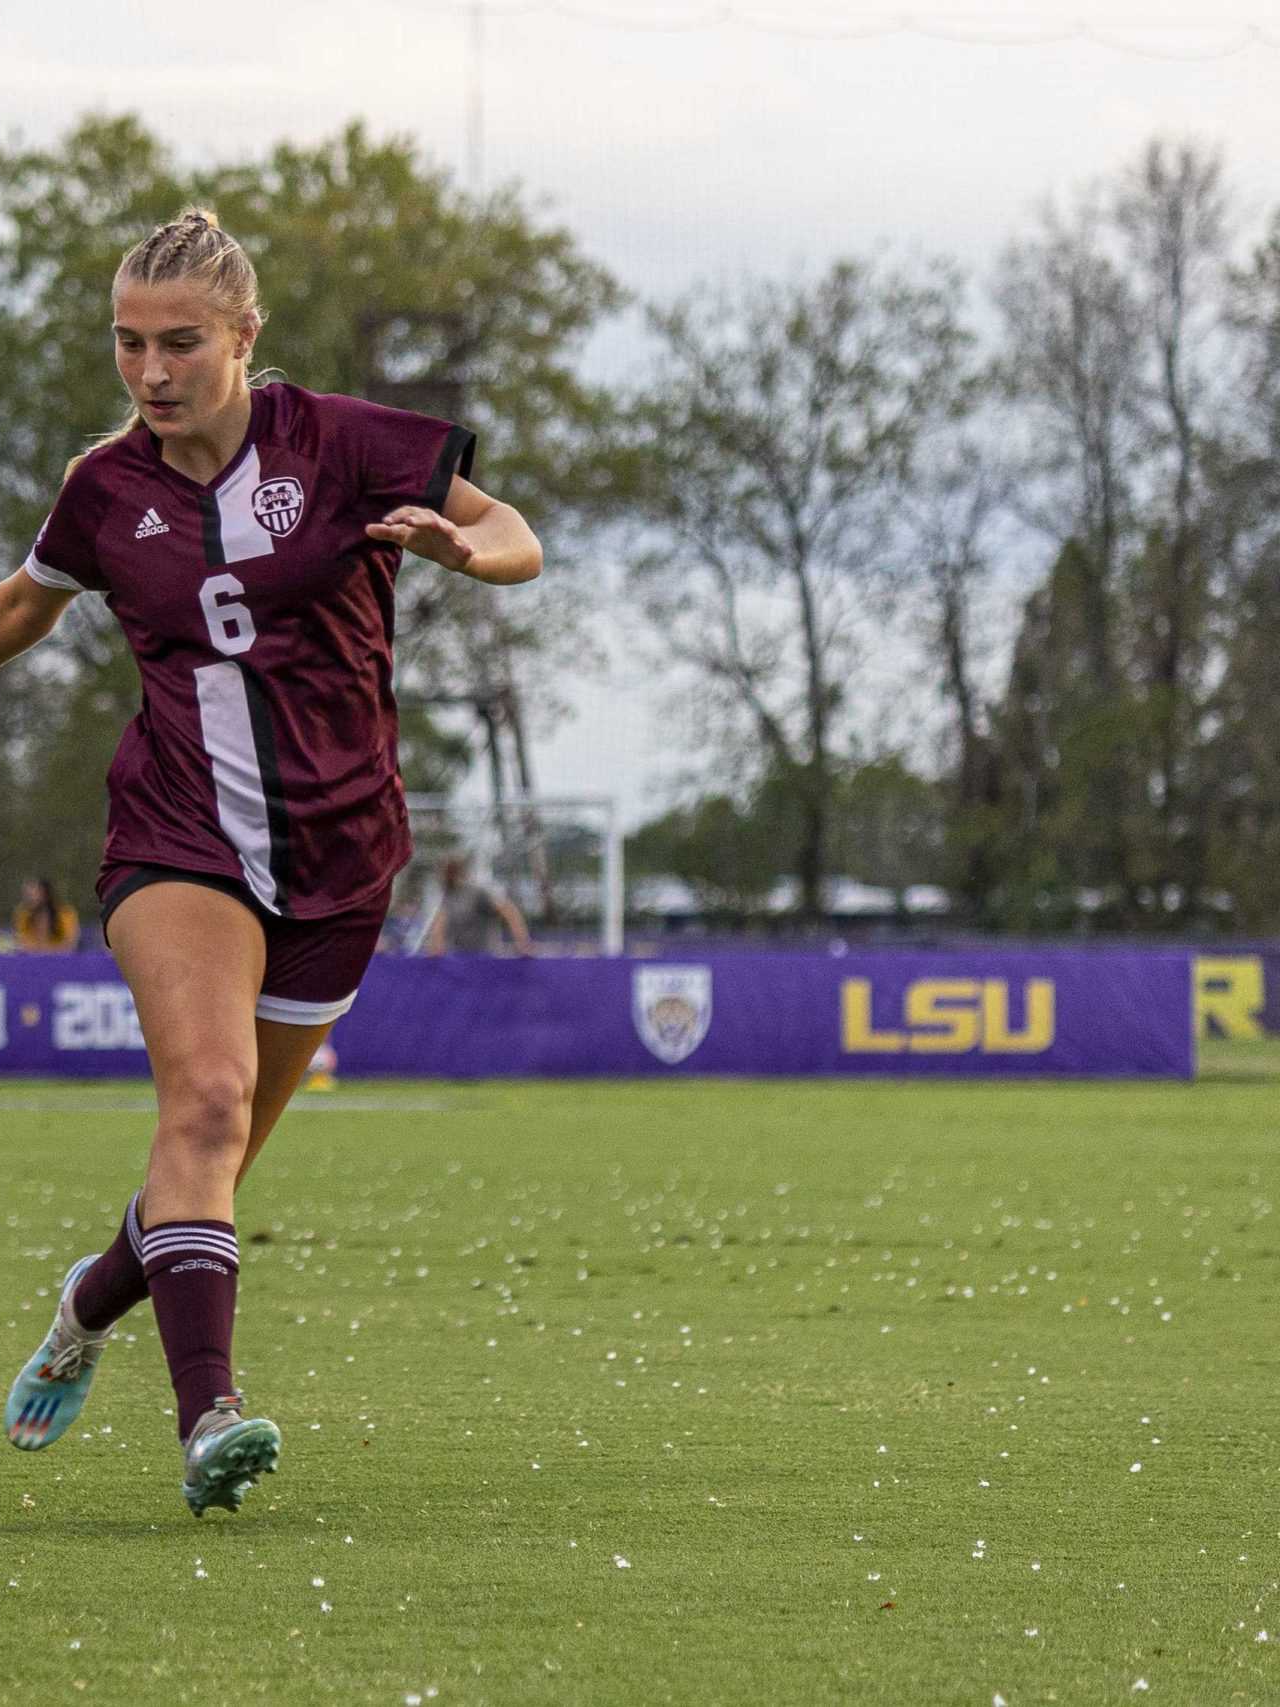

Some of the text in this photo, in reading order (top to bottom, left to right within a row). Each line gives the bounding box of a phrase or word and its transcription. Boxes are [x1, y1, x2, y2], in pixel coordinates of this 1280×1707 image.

[135, 523, 169, 539] adidas
[199, 573, 256, 656] 6
[840, 978, 1055, 1053] LSU
[171, 1258, 228, 1275] adidas
